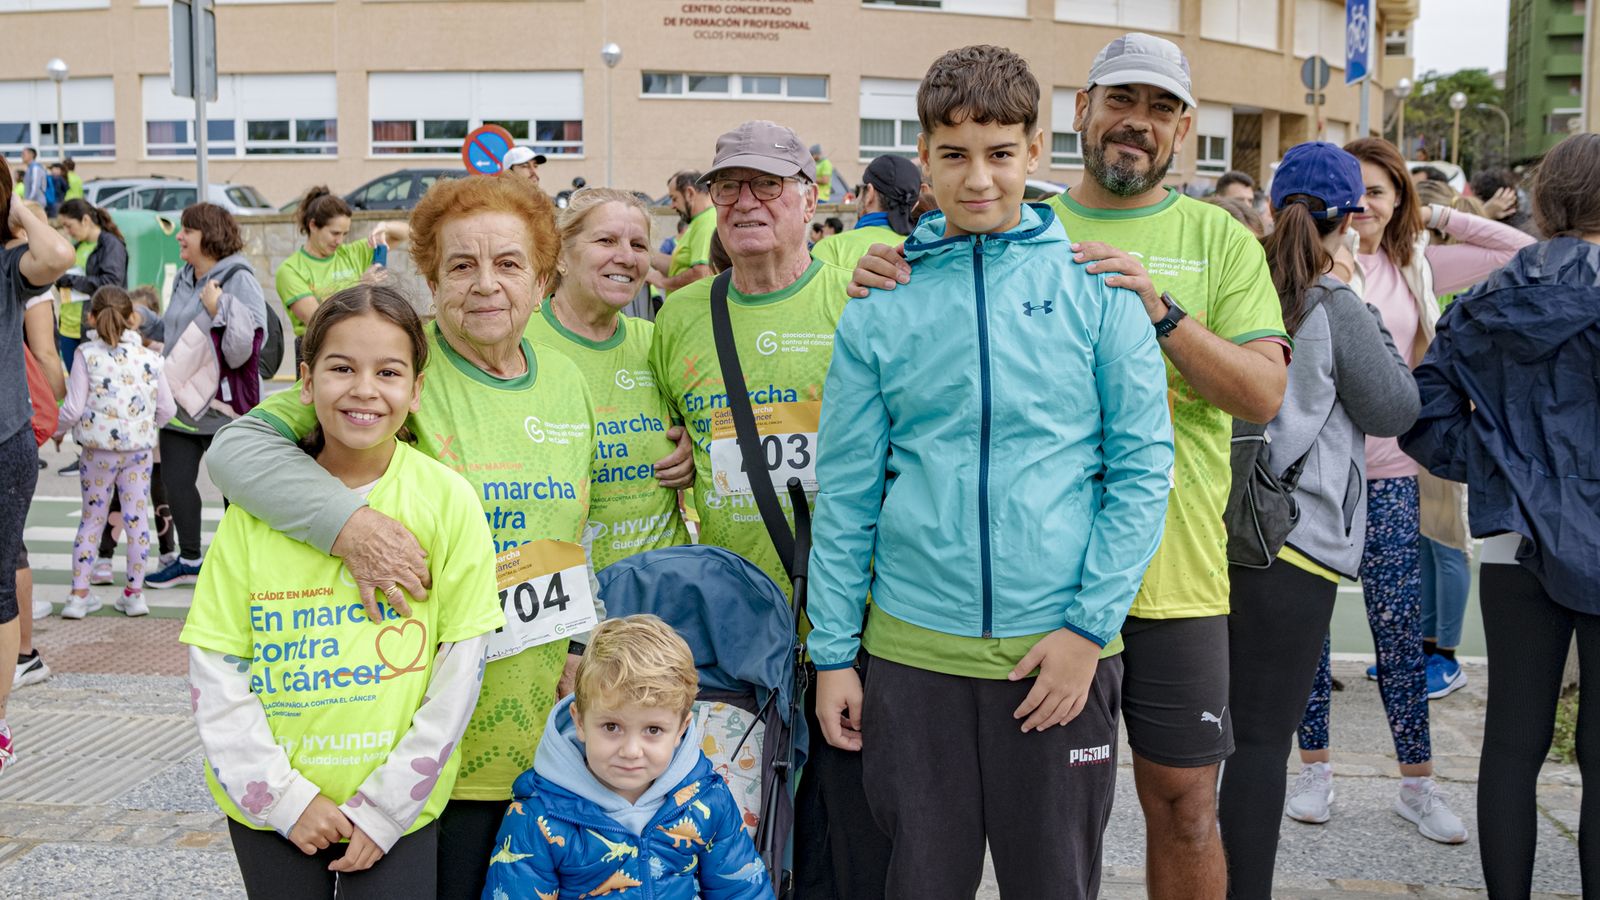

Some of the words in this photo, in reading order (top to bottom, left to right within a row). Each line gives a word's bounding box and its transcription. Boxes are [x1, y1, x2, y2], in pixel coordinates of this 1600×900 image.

[682, 4, 722, 14] CENTRO
[724, 5, 792, 16] CONCERTADO
[663, 17, 677, 26] DE
[680, 17, 740, 28] FORMACIÓN
[743, 19, 811, 30] PROFESIONAL
[693, 30, 724, 40] CICLOS
[726, 31, 780, 42] FORMATIVOS
[684, 392, 704, 412] En
[483, 476, 577, 501] marcha
[257, 590, 285, 601] CÁDIZ
[286, 590, 300, 600] EN
[250, 605, 283, 632] En
[251, 666, 277, 694] el
[283, 664, 386, 692] cáncer
[310, 697, 339, 707] CONTRA
[339, 696, 348, 704] EL
[348, 694, 377, 703] CÁNCER
[1069, 744, 1110, 763] PUMA
